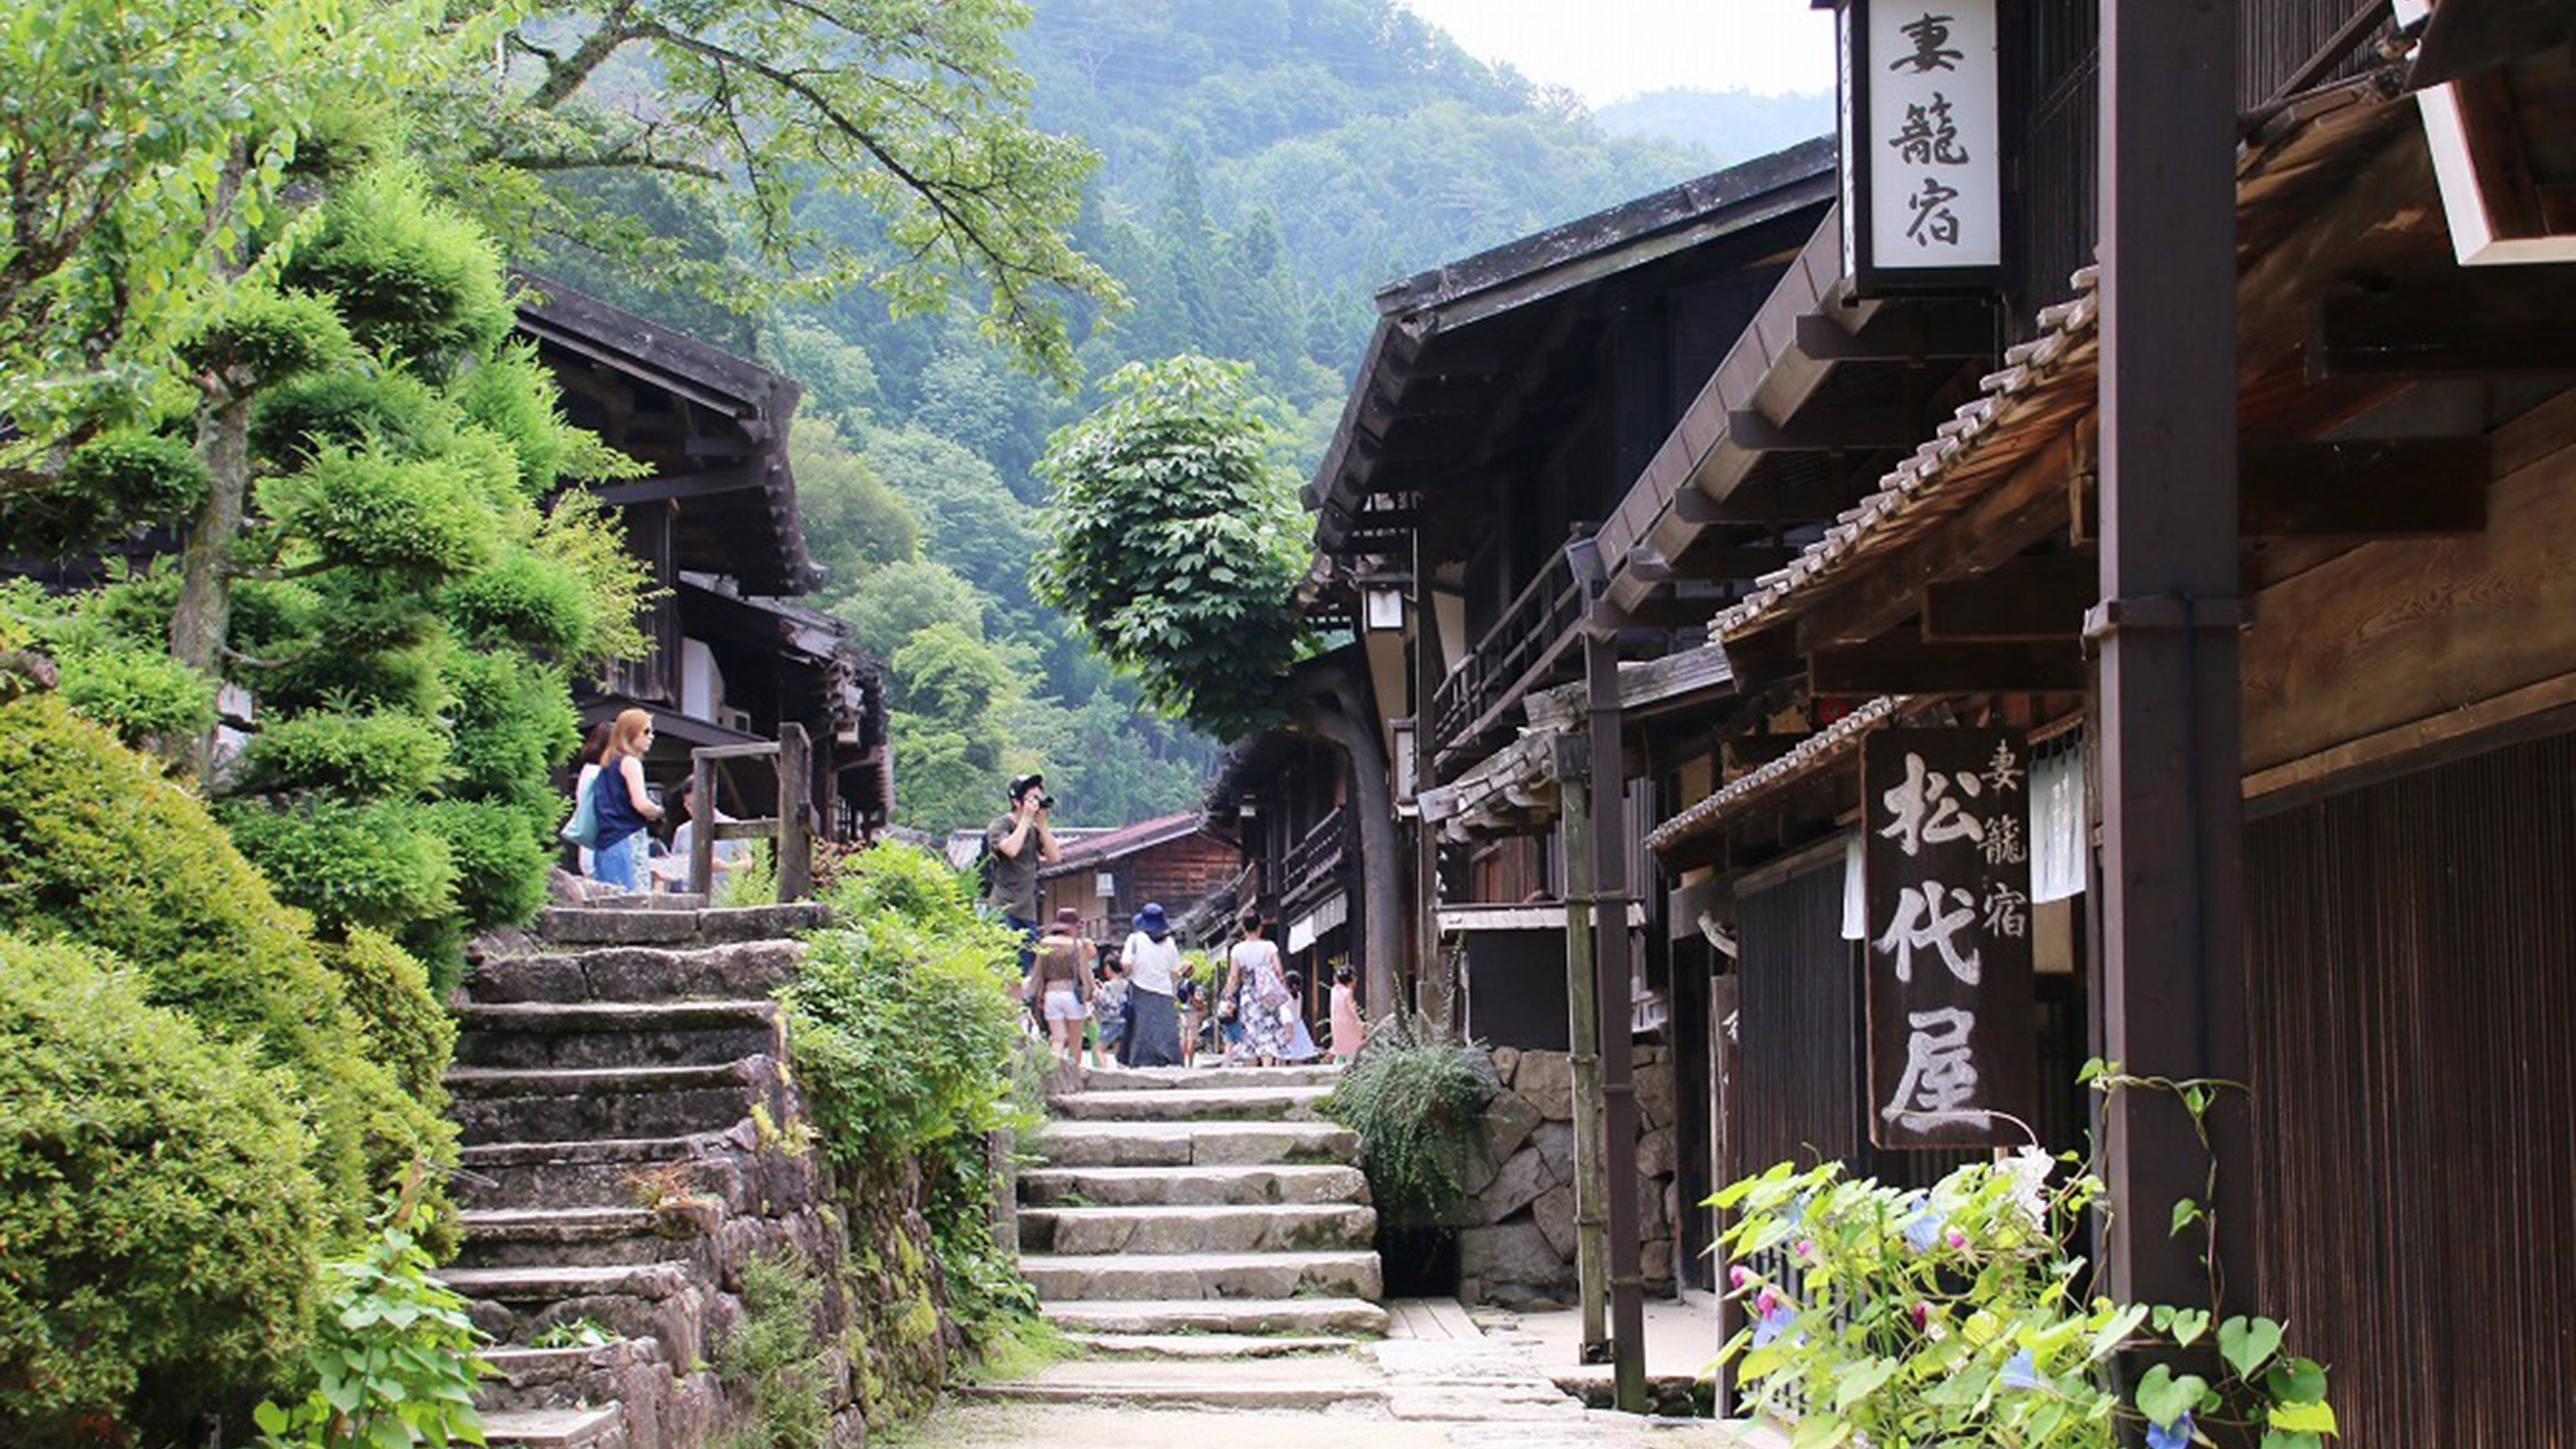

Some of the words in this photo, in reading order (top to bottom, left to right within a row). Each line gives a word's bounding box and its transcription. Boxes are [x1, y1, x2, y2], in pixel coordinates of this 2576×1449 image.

[1889, 13, 1970, 246] 妻籠宿
[1872, 752, 1992, 1134] 松代屋
[1976, 738, 2027, 938] 妻籠宿
